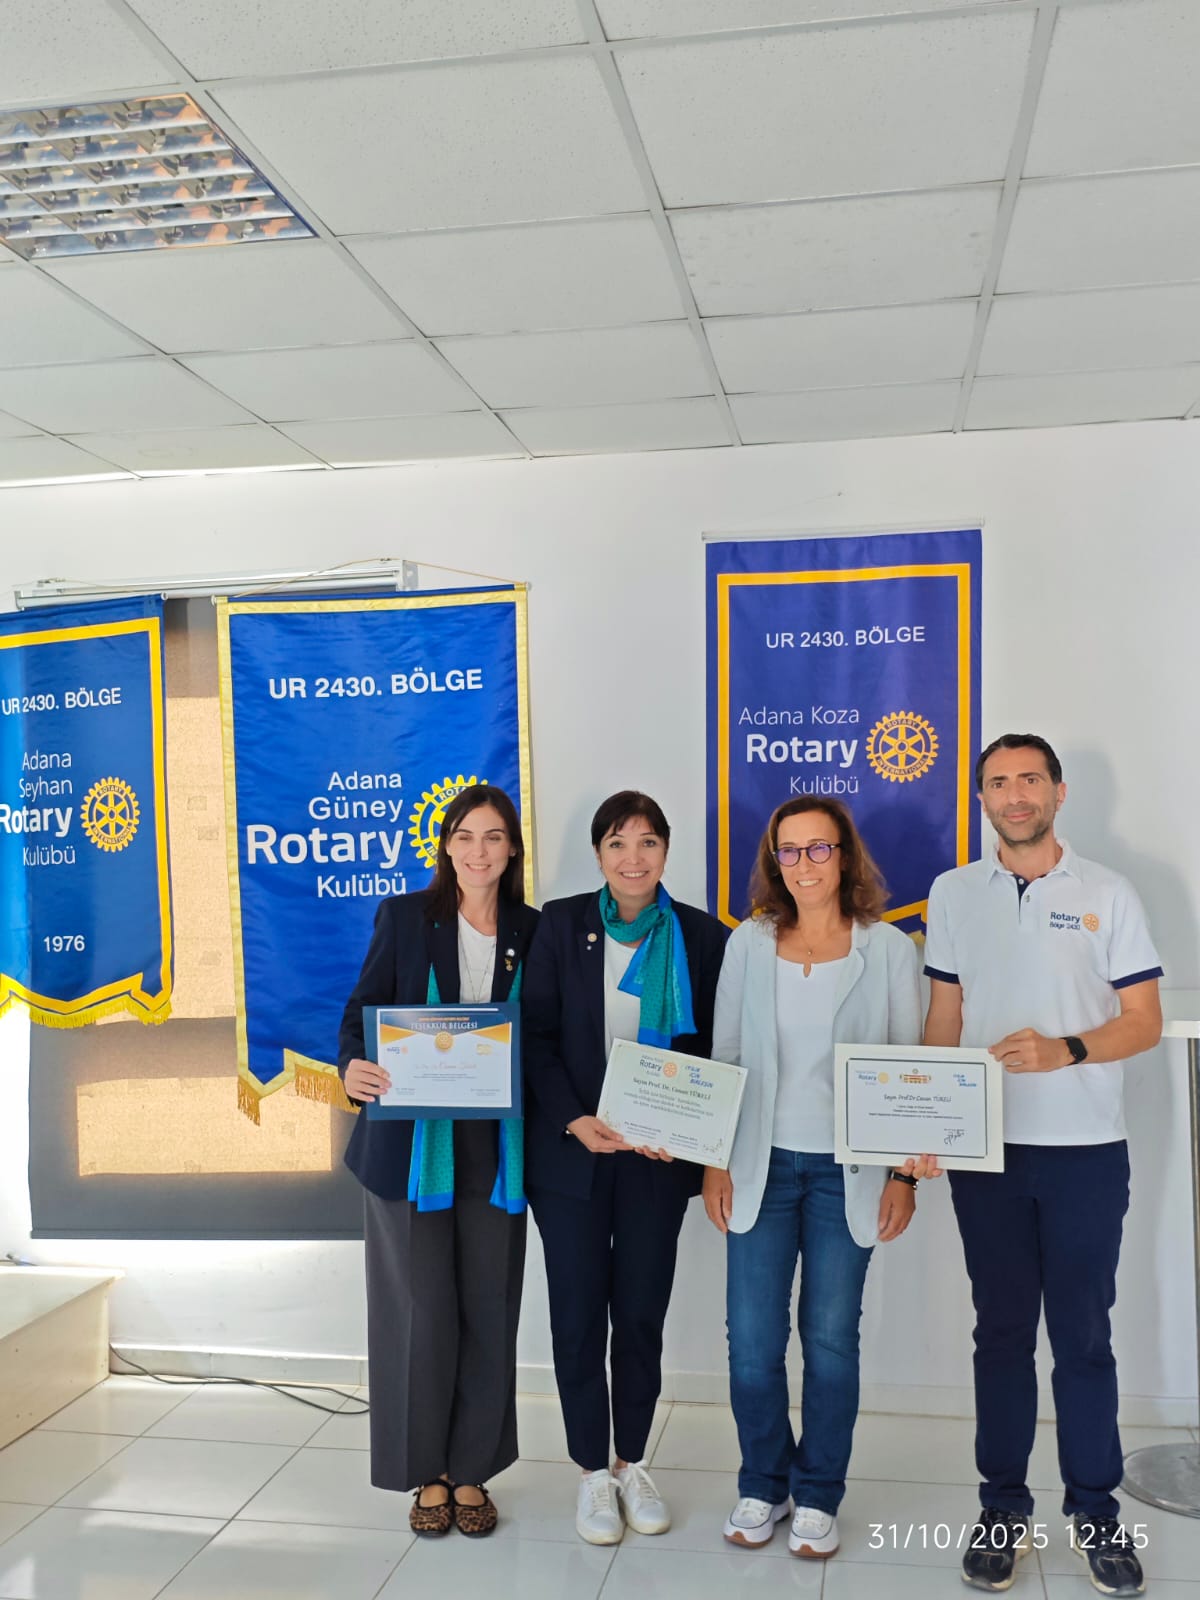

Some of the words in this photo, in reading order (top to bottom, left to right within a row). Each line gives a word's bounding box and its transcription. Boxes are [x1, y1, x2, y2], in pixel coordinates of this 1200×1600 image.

[766, 633, 795, 649] UR
[800, 631, 849, 648] 2430.
[855, 625, 926, 646] BÖLGE
[269, 678, 307, 699] UR
[314, 676, 382, 698] 2430.
[391, 667, 483, 695] BÖLGE
[1, 697, 20, 715] UR
[22, 694, 60, 713] 2430.
[65, 687, 122, 709] BÖLGE
[738, 705, 803, 725] Adana
[811, 705, 860, 725] Koza
[21, 749, 73, 771] Adana
[746, 733, 859, 768] Rotary
[19, 775, 73, 802] Seyhan
[327, 770, 402, 791] Adana
[789, 774, 860, 795] Kulübü
[0, 803, 73, 838] Rotary
[308, 796, 403, 823] Güney
[23, 844, 76, 867] Kulübü
[246, 824, 404, 869] Rotary
[317, 872, 407, 898] Kulübü
[1050, 911, 1081, 924] Rotary
[43, 934, 85, 952] 1976
[640, 1059, 662, 1071] Rotary
